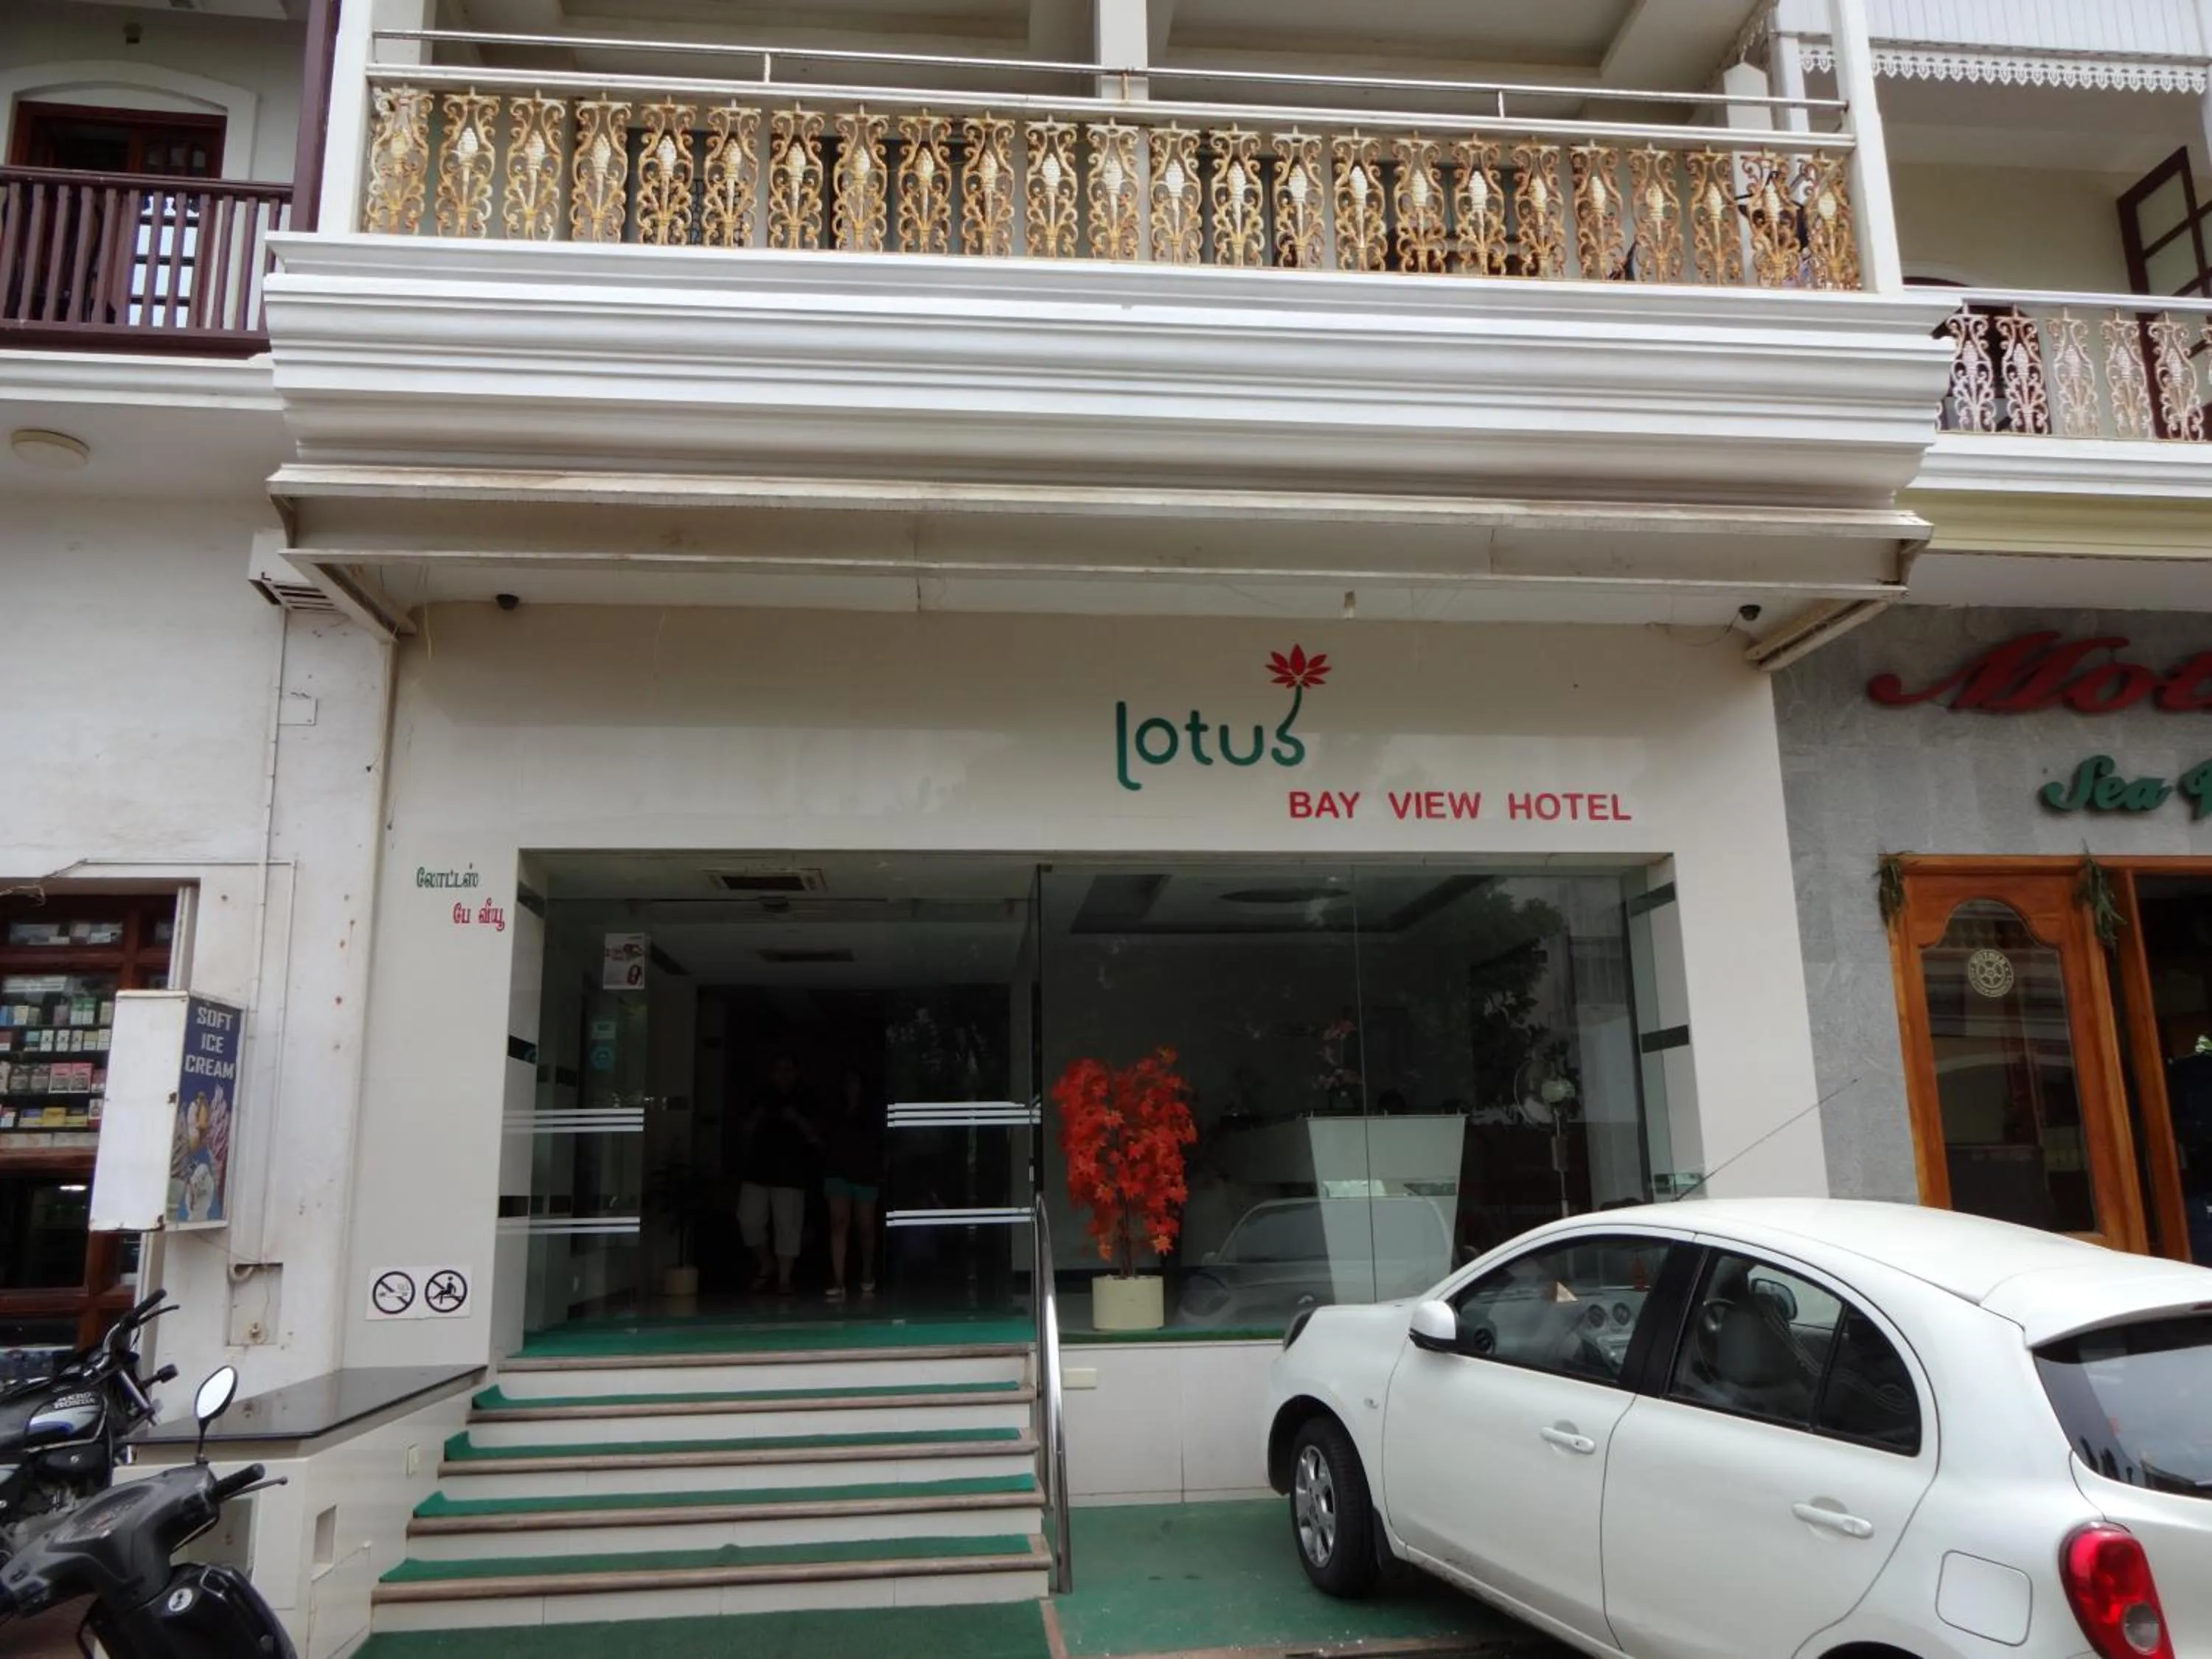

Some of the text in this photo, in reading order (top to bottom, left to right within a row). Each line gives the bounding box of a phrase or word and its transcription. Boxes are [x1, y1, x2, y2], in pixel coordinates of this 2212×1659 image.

[1116, 687, 1306, 791] lotus
[1288, 790, 1632, 821] BAY VIEW HOTEL
[195, 1006, 234, 1032] SOFT
[201, 1033, 225, 1054] ICE
[184, 1054, 235, 1080] CREAM
